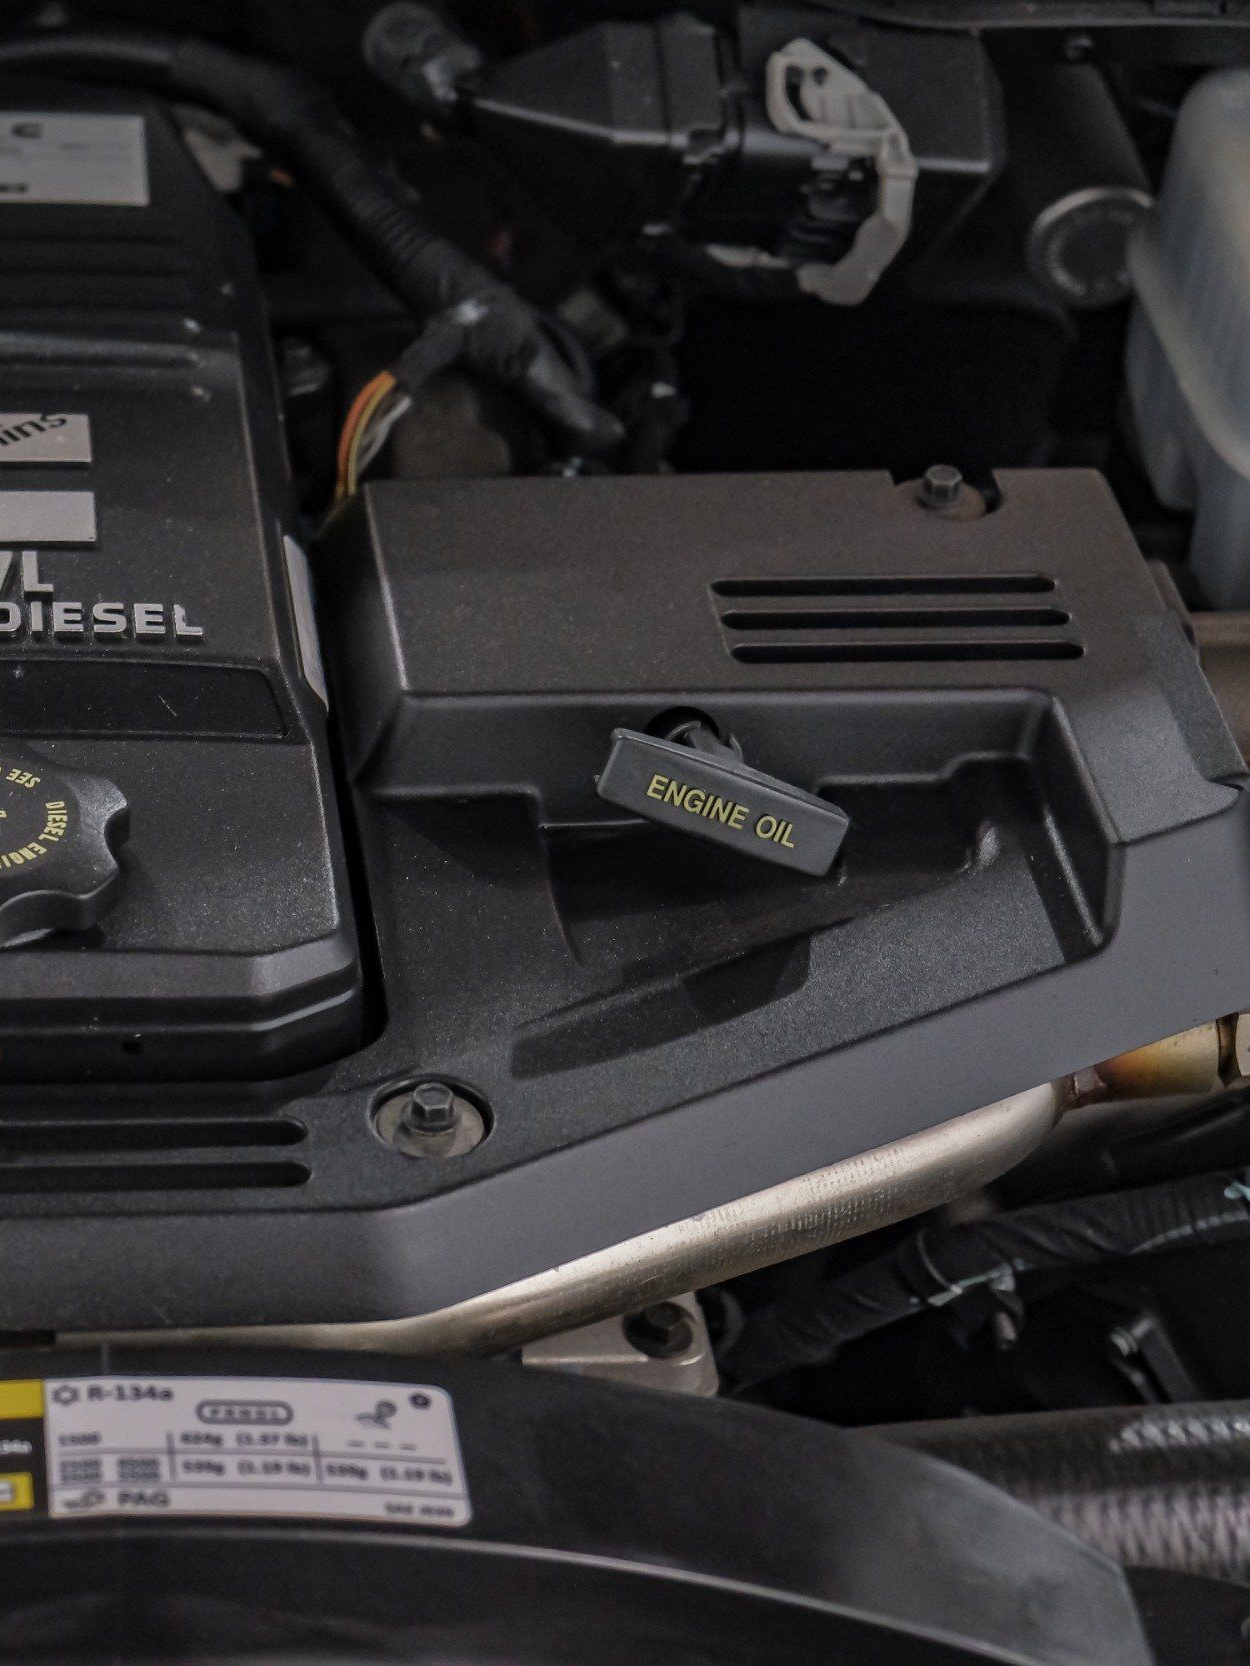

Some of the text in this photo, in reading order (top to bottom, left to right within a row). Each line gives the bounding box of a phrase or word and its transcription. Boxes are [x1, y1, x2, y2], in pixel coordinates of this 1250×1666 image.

[6, 767, 41, 788] SEE
[38, 800, 68, 842] DIESEL
[646, 773, 796, 849] ENGINE OIL
[87, 1385, 175, 1402] R-134a
